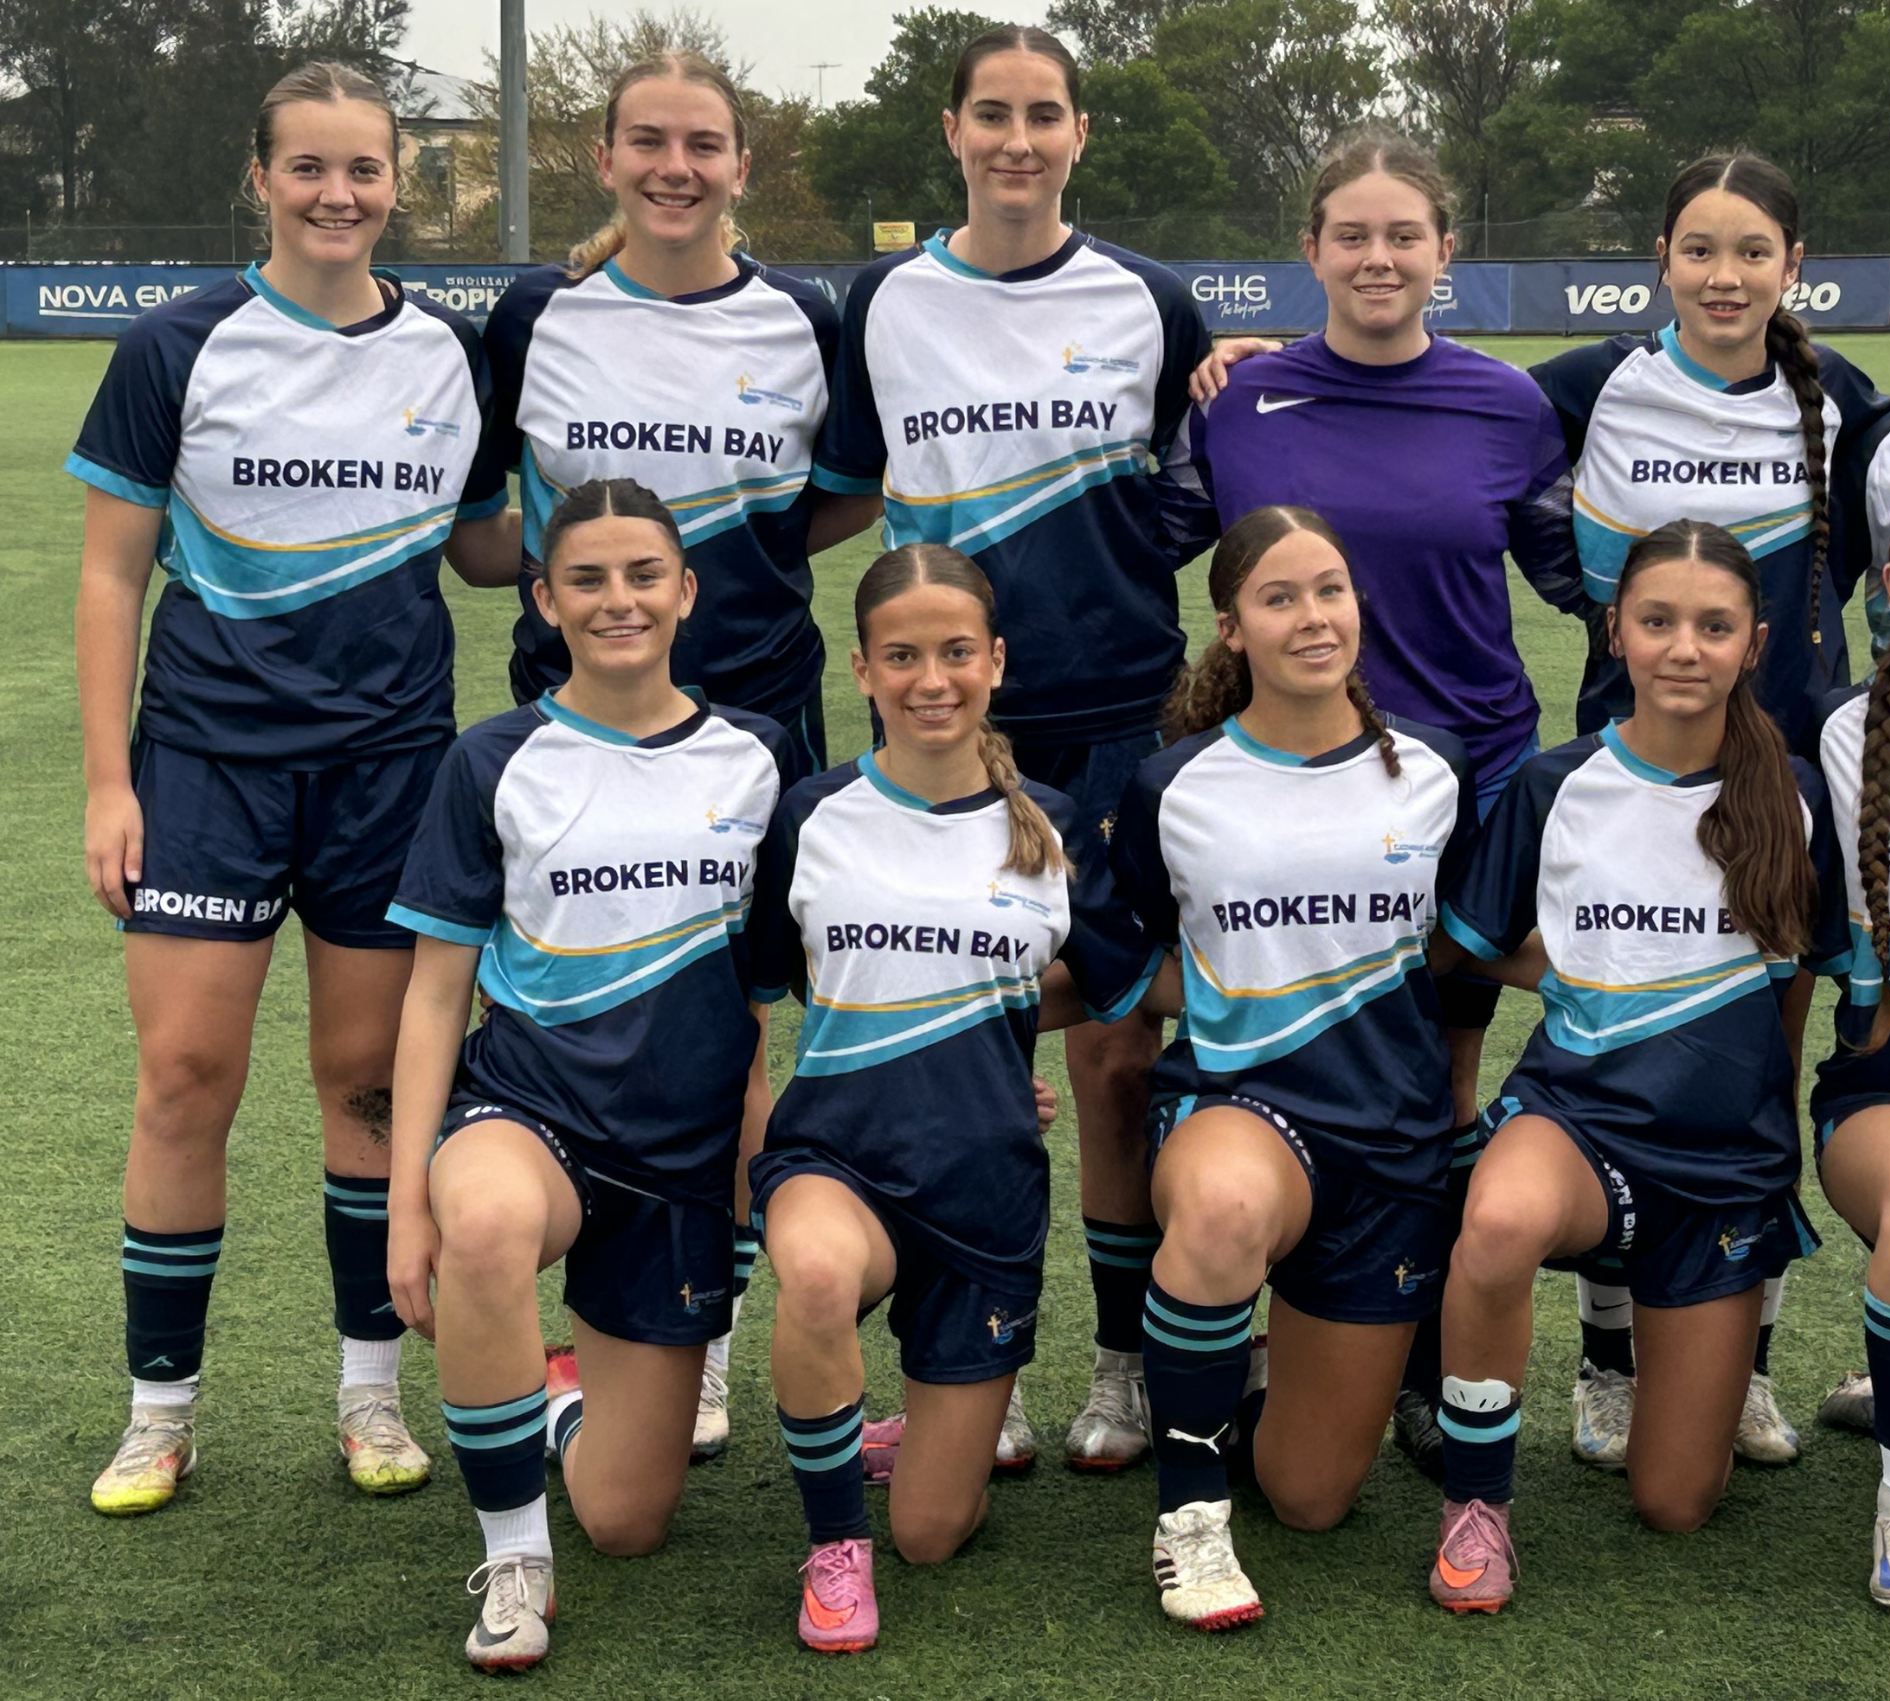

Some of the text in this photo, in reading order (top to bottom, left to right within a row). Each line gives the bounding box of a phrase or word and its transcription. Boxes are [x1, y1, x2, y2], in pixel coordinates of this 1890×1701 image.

[39, 285, 199, 308] NOVA EM
[1191, 274, 1267, 301] GHG
[1564, 284, 1651, 314] veo
[1781, 281, 1841, 311] eo
[902, 399, 1117, 445] BROKEN BAY
[566, 420, 785, 464] BROKEN BAY
[232, 457, 444, 495] BROKEN BAY
[1630, 459, 1812, 485] BROKEN BA
[549, 858, 750, 898] BROKEN BAY
[133, 888, 247, 923] BROKEN
[1213, 892, 1426, 932] BROKEN BAY
[1574, 903, 1707, 935] BROKEN
[826, 923, 1030, 964] BROKEN BAY
